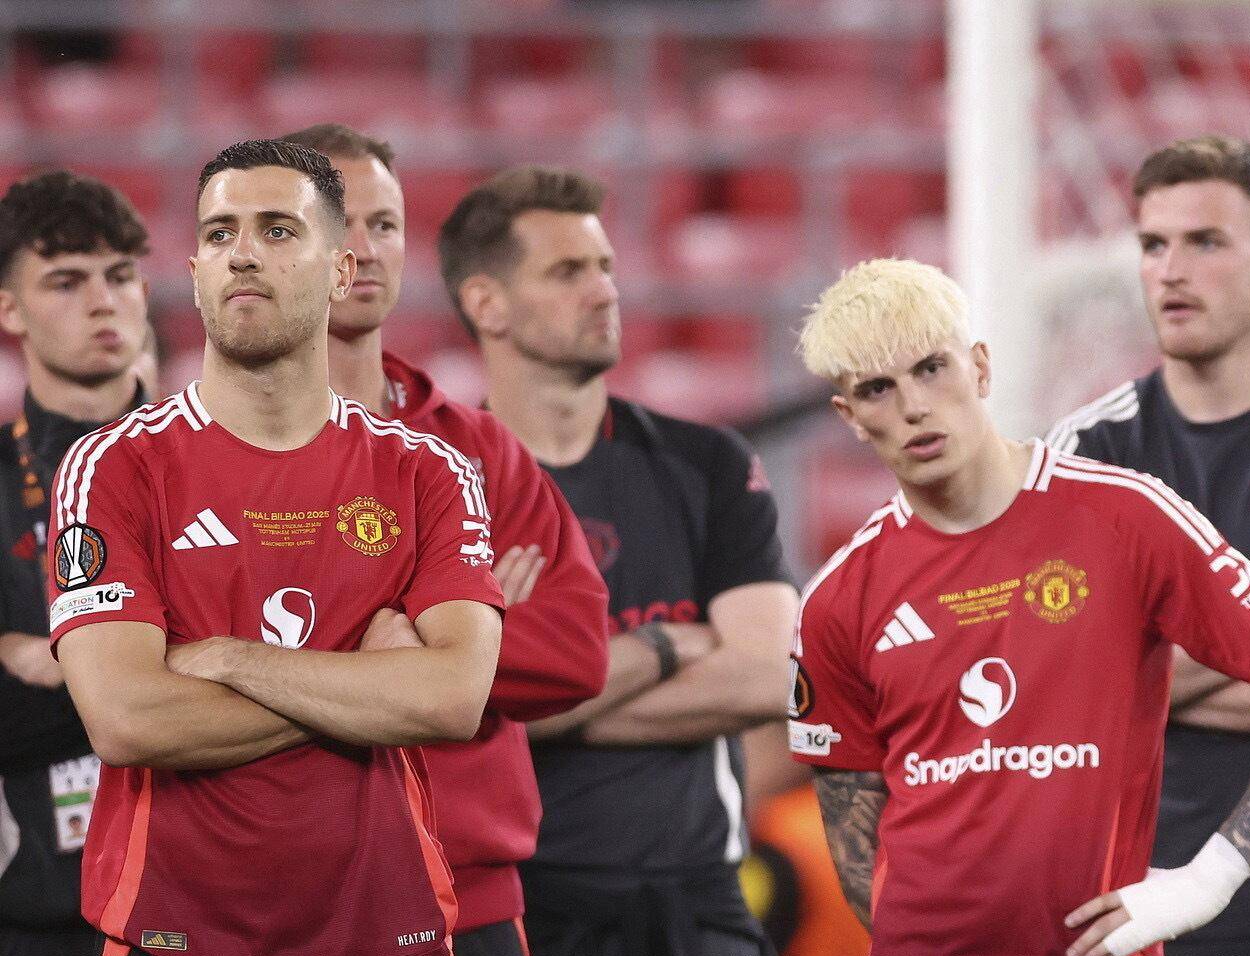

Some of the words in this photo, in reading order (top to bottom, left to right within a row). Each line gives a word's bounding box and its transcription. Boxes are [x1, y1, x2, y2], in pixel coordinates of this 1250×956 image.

[243, 509, 270, 520] FINAL
[271, 512, 305, 521] BILBAO
[307, 510, 330, 519] 2025
[341, 500, 393, 522] MANCHESTER
[353, 540, 389, 552] UNITED
[96, 589, 120, 604] 10
[903, 738, 1100, 787] Snapdragon
[397, 929, 437, 947] HEAT.RDY
